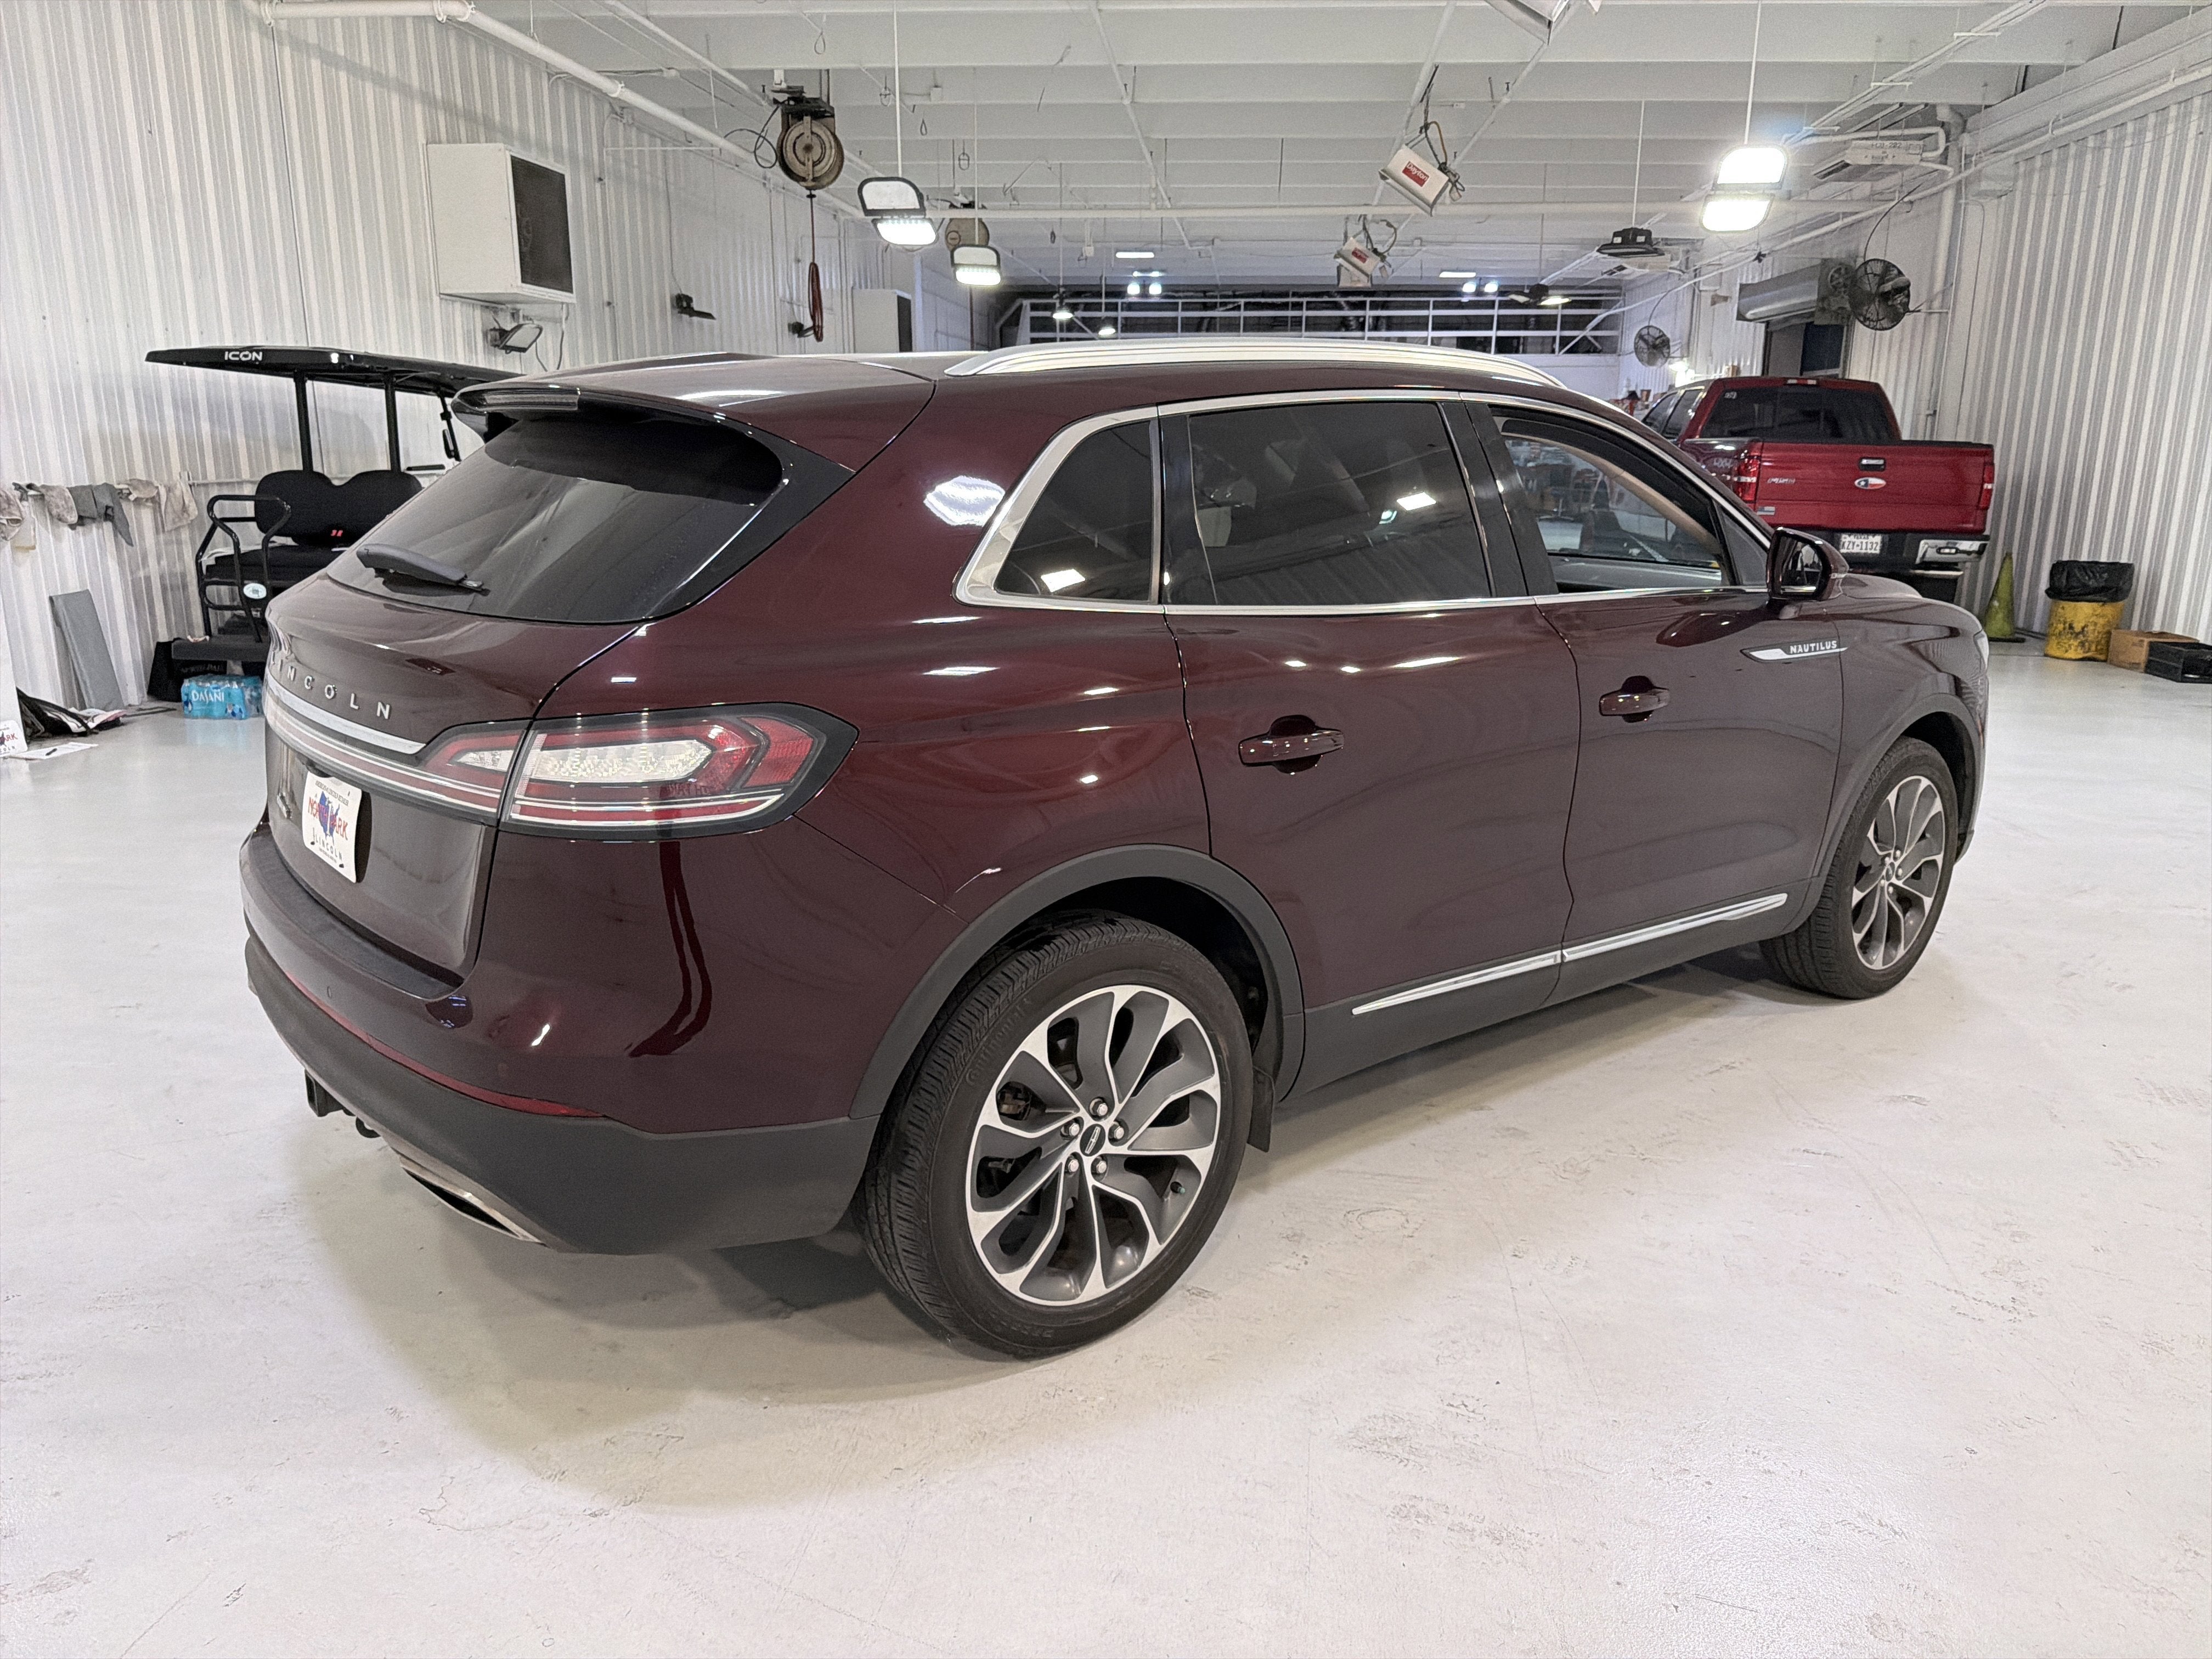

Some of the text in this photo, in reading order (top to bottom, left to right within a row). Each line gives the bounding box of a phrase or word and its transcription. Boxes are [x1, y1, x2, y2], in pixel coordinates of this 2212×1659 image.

[1407, 163, 1428, 181] Dayton
[224, 351, 263, 361] ICON
[1790, 640, 1837, 654] NAUTILUS
[272, 651, 391, 720] LINCOLN
[192, 690, 225, 704] DASANI
[316, 833, 342, 860] LINCOLN
